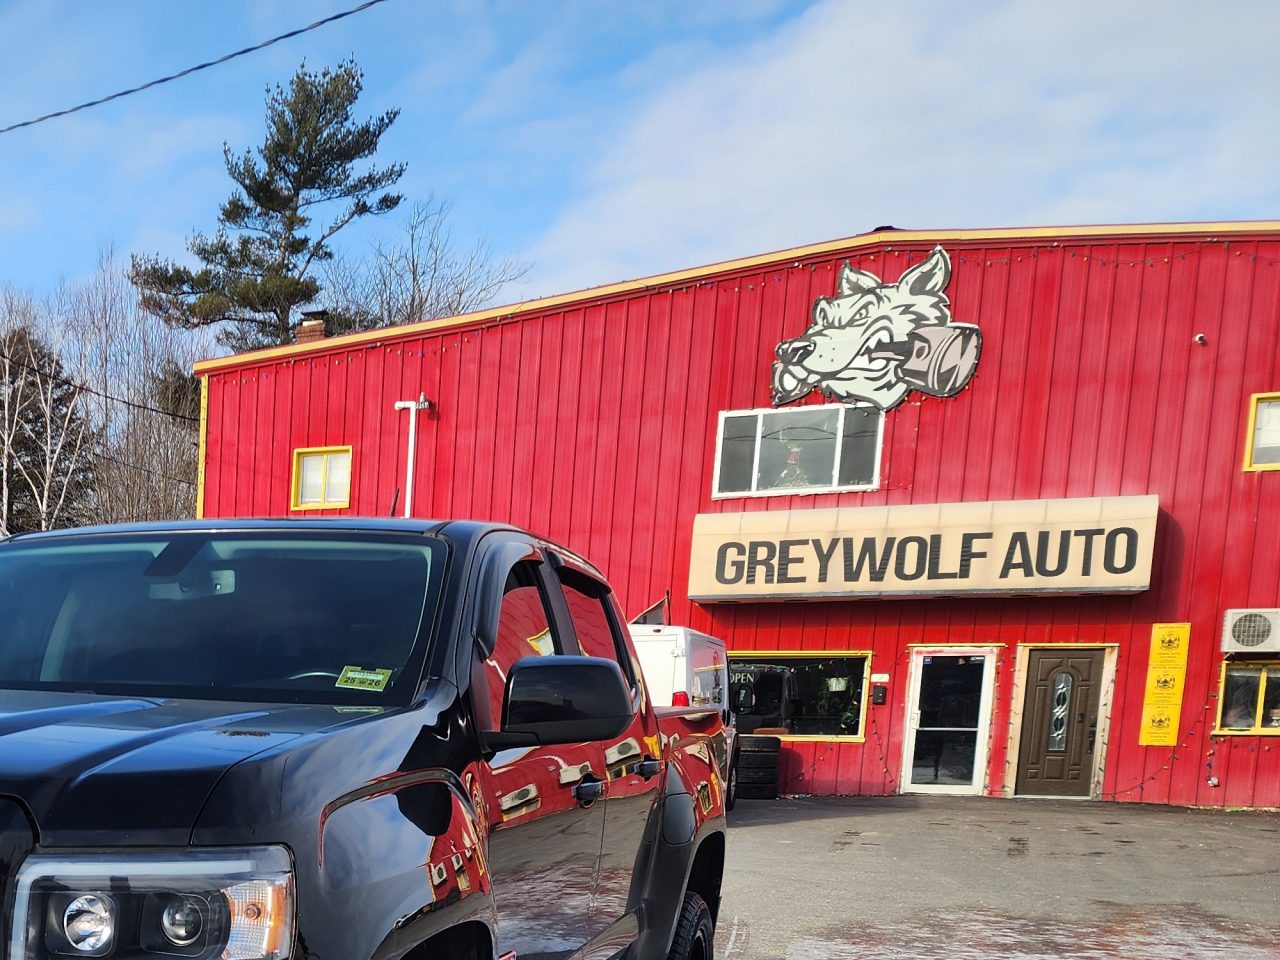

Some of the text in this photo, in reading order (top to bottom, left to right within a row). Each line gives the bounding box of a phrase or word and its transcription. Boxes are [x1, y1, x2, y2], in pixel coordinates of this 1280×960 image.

[715, 526, 1138, 585] GREYWOLF AUTO
[344, 676, 356, 684] 25
[367, 679, 381, 687] 26
